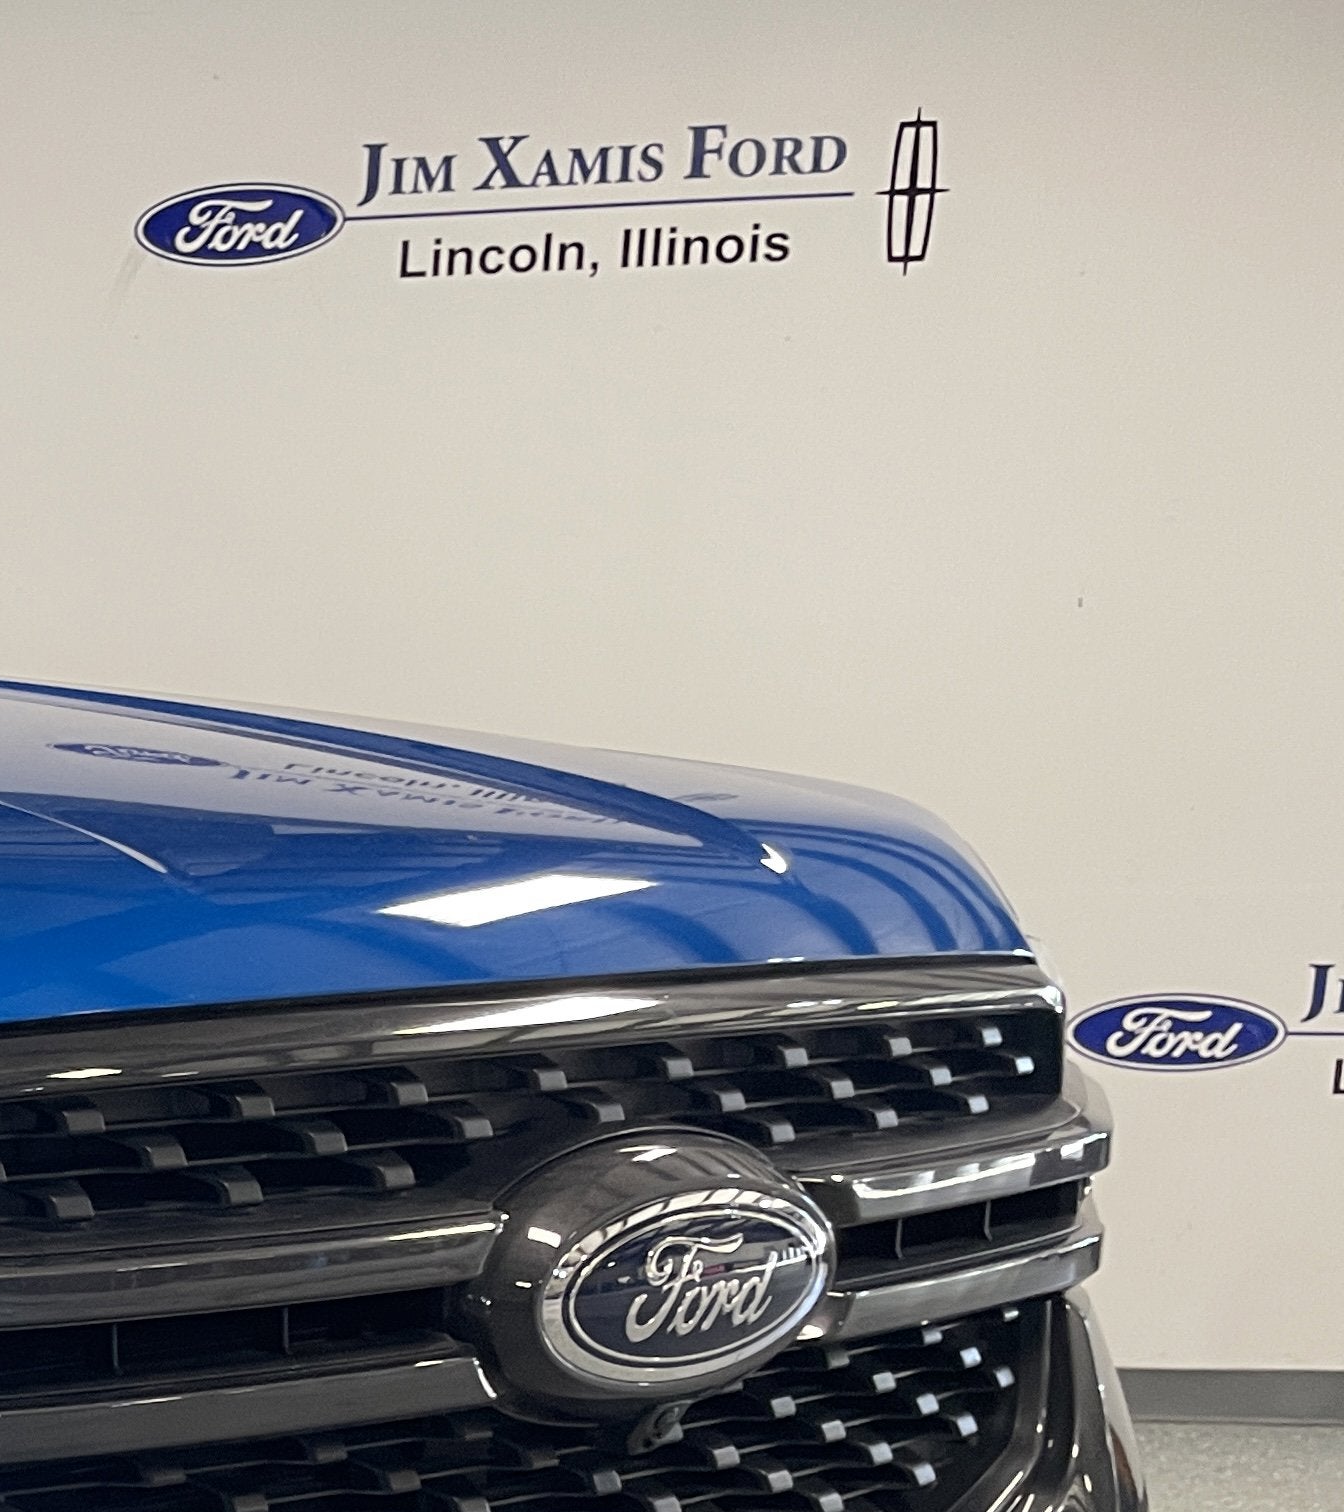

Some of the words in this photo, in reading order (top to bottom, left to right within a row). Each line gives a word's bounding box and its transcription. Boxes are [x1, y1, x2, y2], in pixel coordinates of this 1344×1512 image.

[357, 142, 458, 207] JIM
[472, 134, 664, 190] XAMIS
[683, 124, 848, 180] FORD
[174, 199, 305, 254] Ford
[400, 232, 600, 279] Lincoln,
[620, 223, 791, 269] Illinois
[1105, 1006, 1244, 1058] Ford
[625, 1232, 779, 1343] Ford
